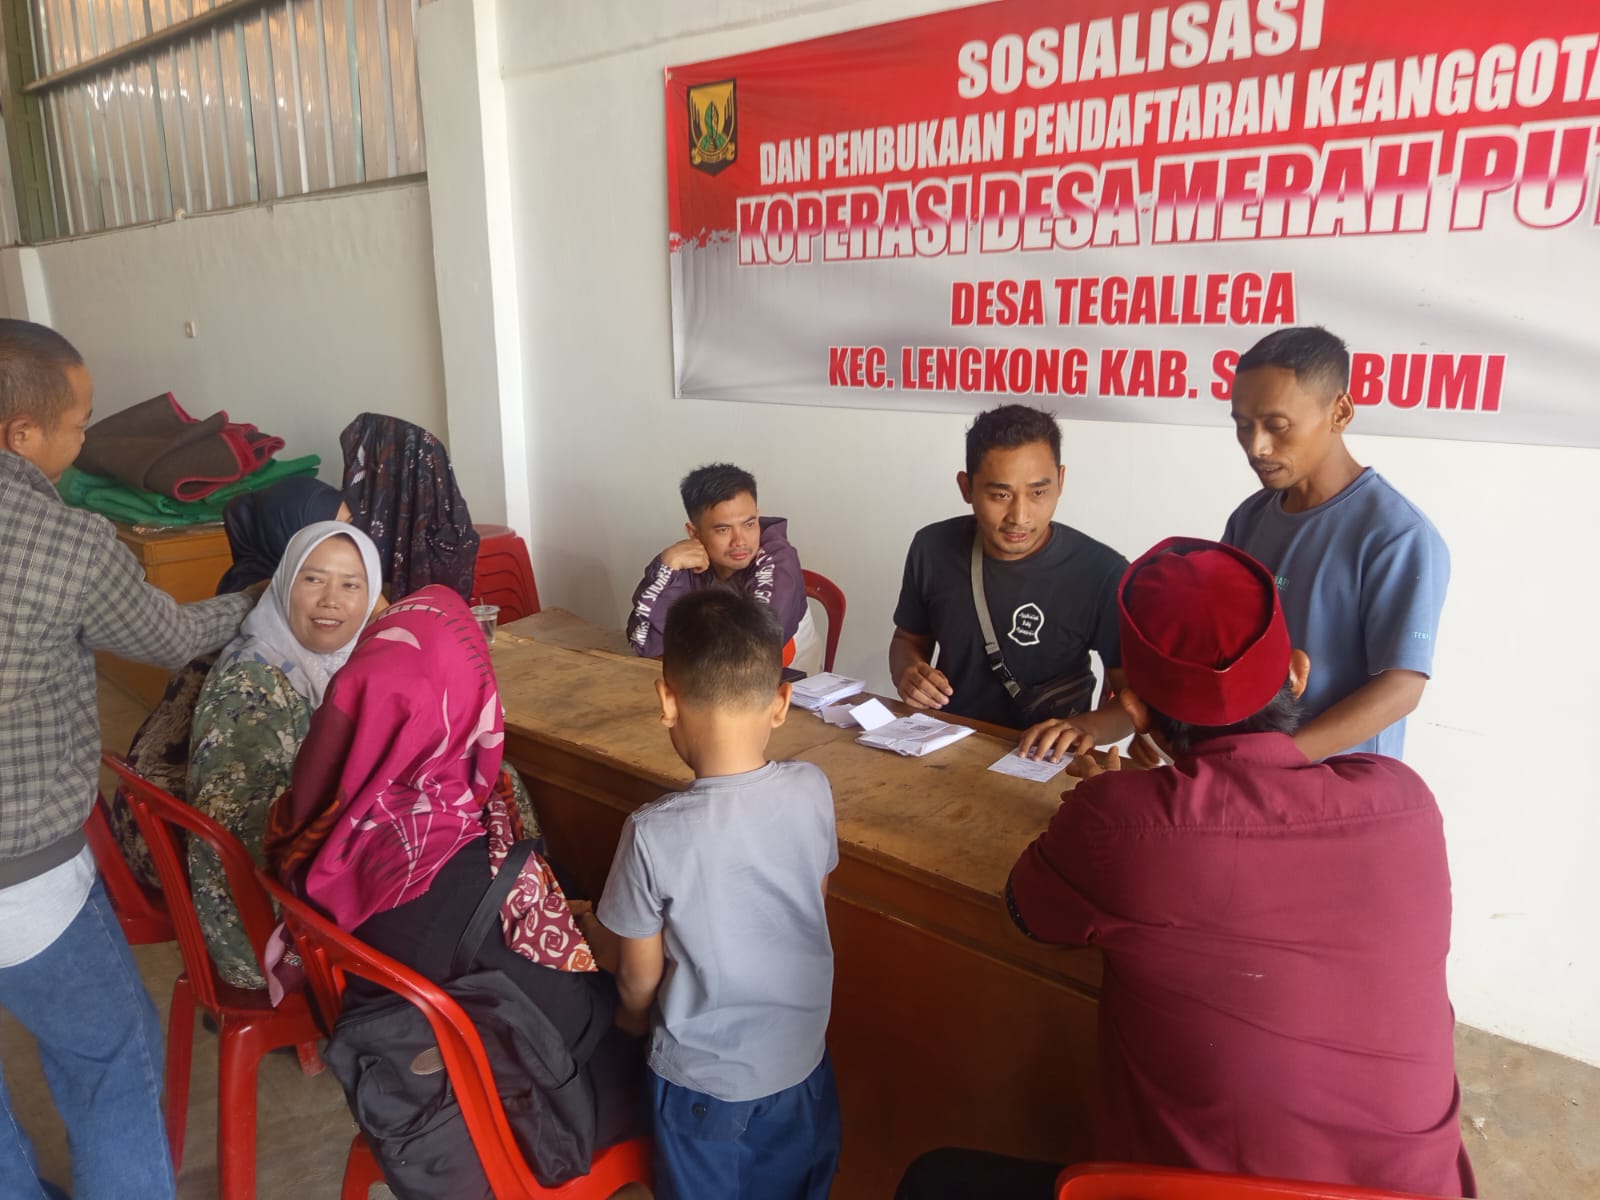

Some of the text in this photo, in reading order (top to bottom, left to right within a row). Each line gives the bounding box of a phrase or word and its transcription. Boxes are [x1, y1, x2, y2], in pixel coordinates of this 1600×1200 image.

[958, 0, 1324, 99] SOSIALISASI
[760, 136, 811, 185] DAN
[818, 110, 1005, 179] PEMBUKAAN
[1013, 72, 1295, 158] PENDAFTARAN
[737, 115, 1600, 266] KOPERASI DESA MERAH PU
[951, 271, 1296, 327] DESA TEGALLEGA
[828, 346, 1507, 413] KEC. LENGKONG KAB. SBUMI
